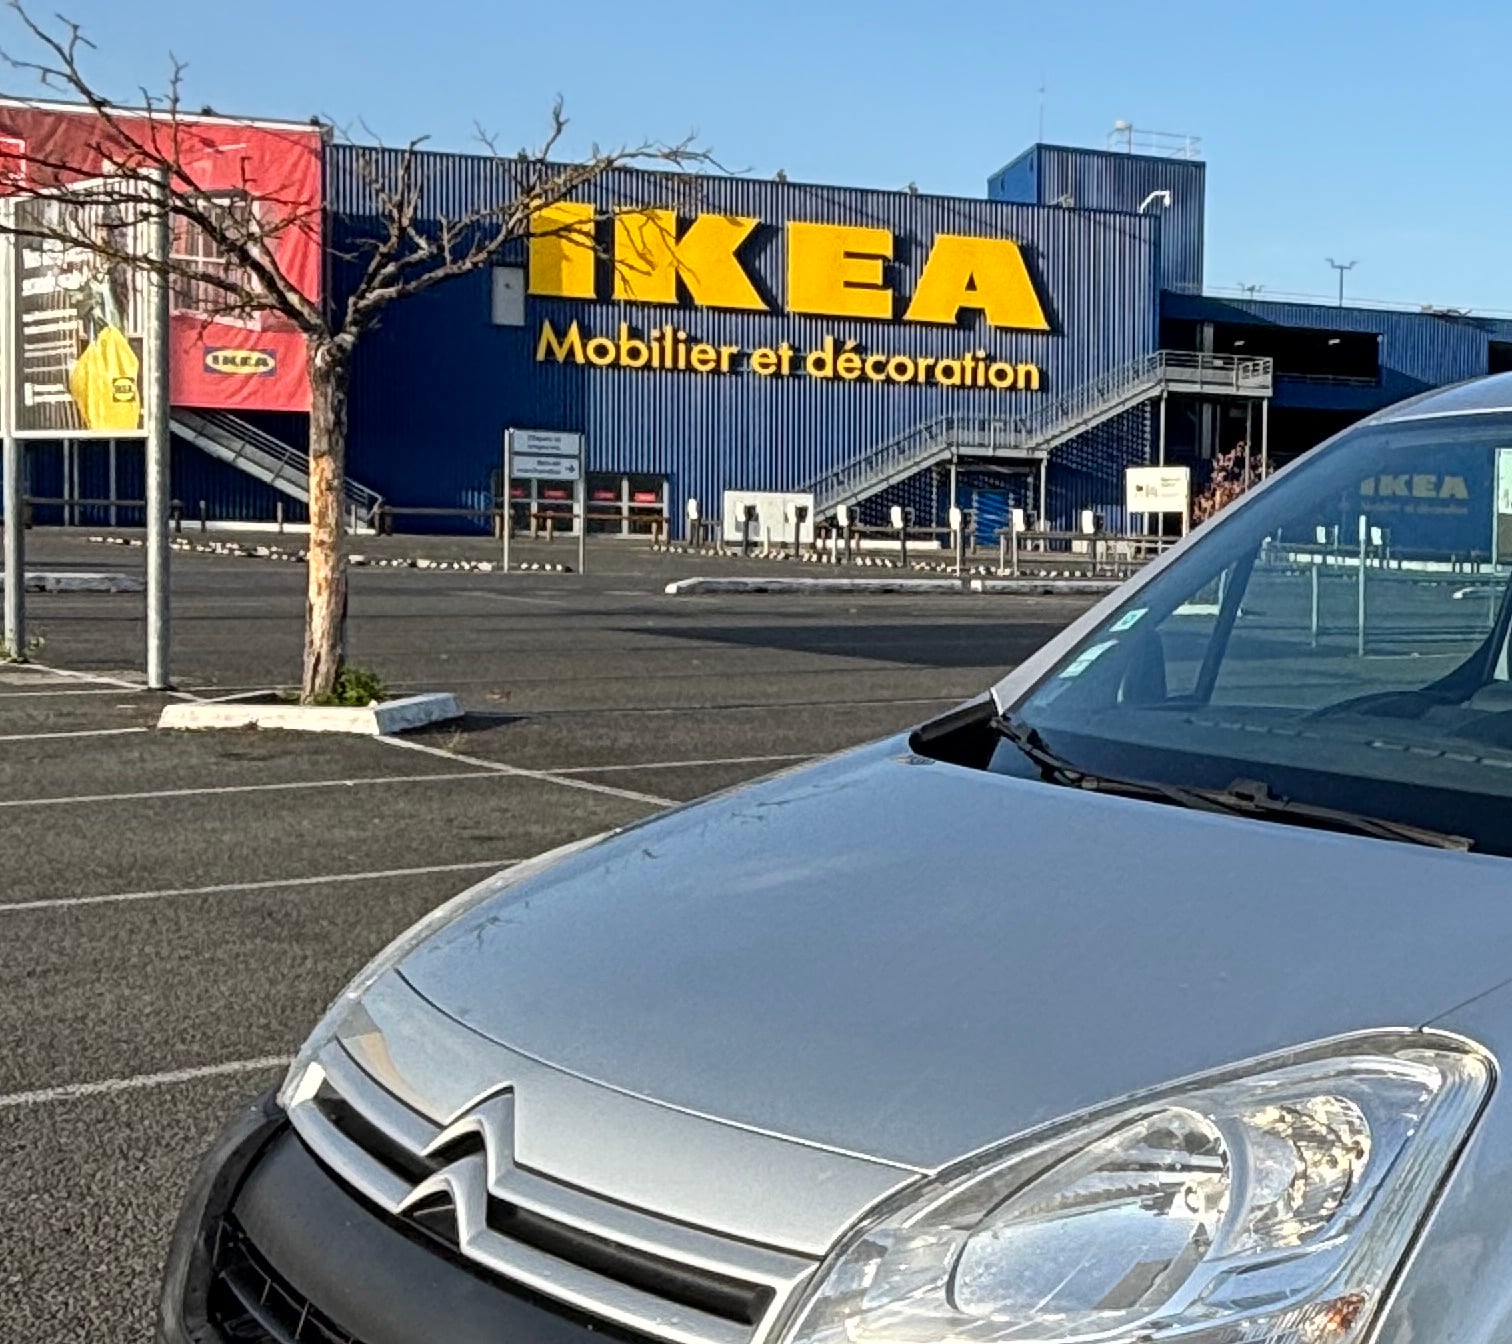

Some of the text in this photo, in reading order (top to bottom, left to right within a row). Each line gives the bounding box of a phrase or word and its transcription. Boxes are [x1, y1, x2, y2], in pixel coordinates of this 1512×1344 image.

[527, 199, 1051, 330] IKEA
[212, 355, 269, 367] IKEA
[534, 318, 1041, 391] Mobilier et décoration
[1360, 474, 1470, 499] IKEA
